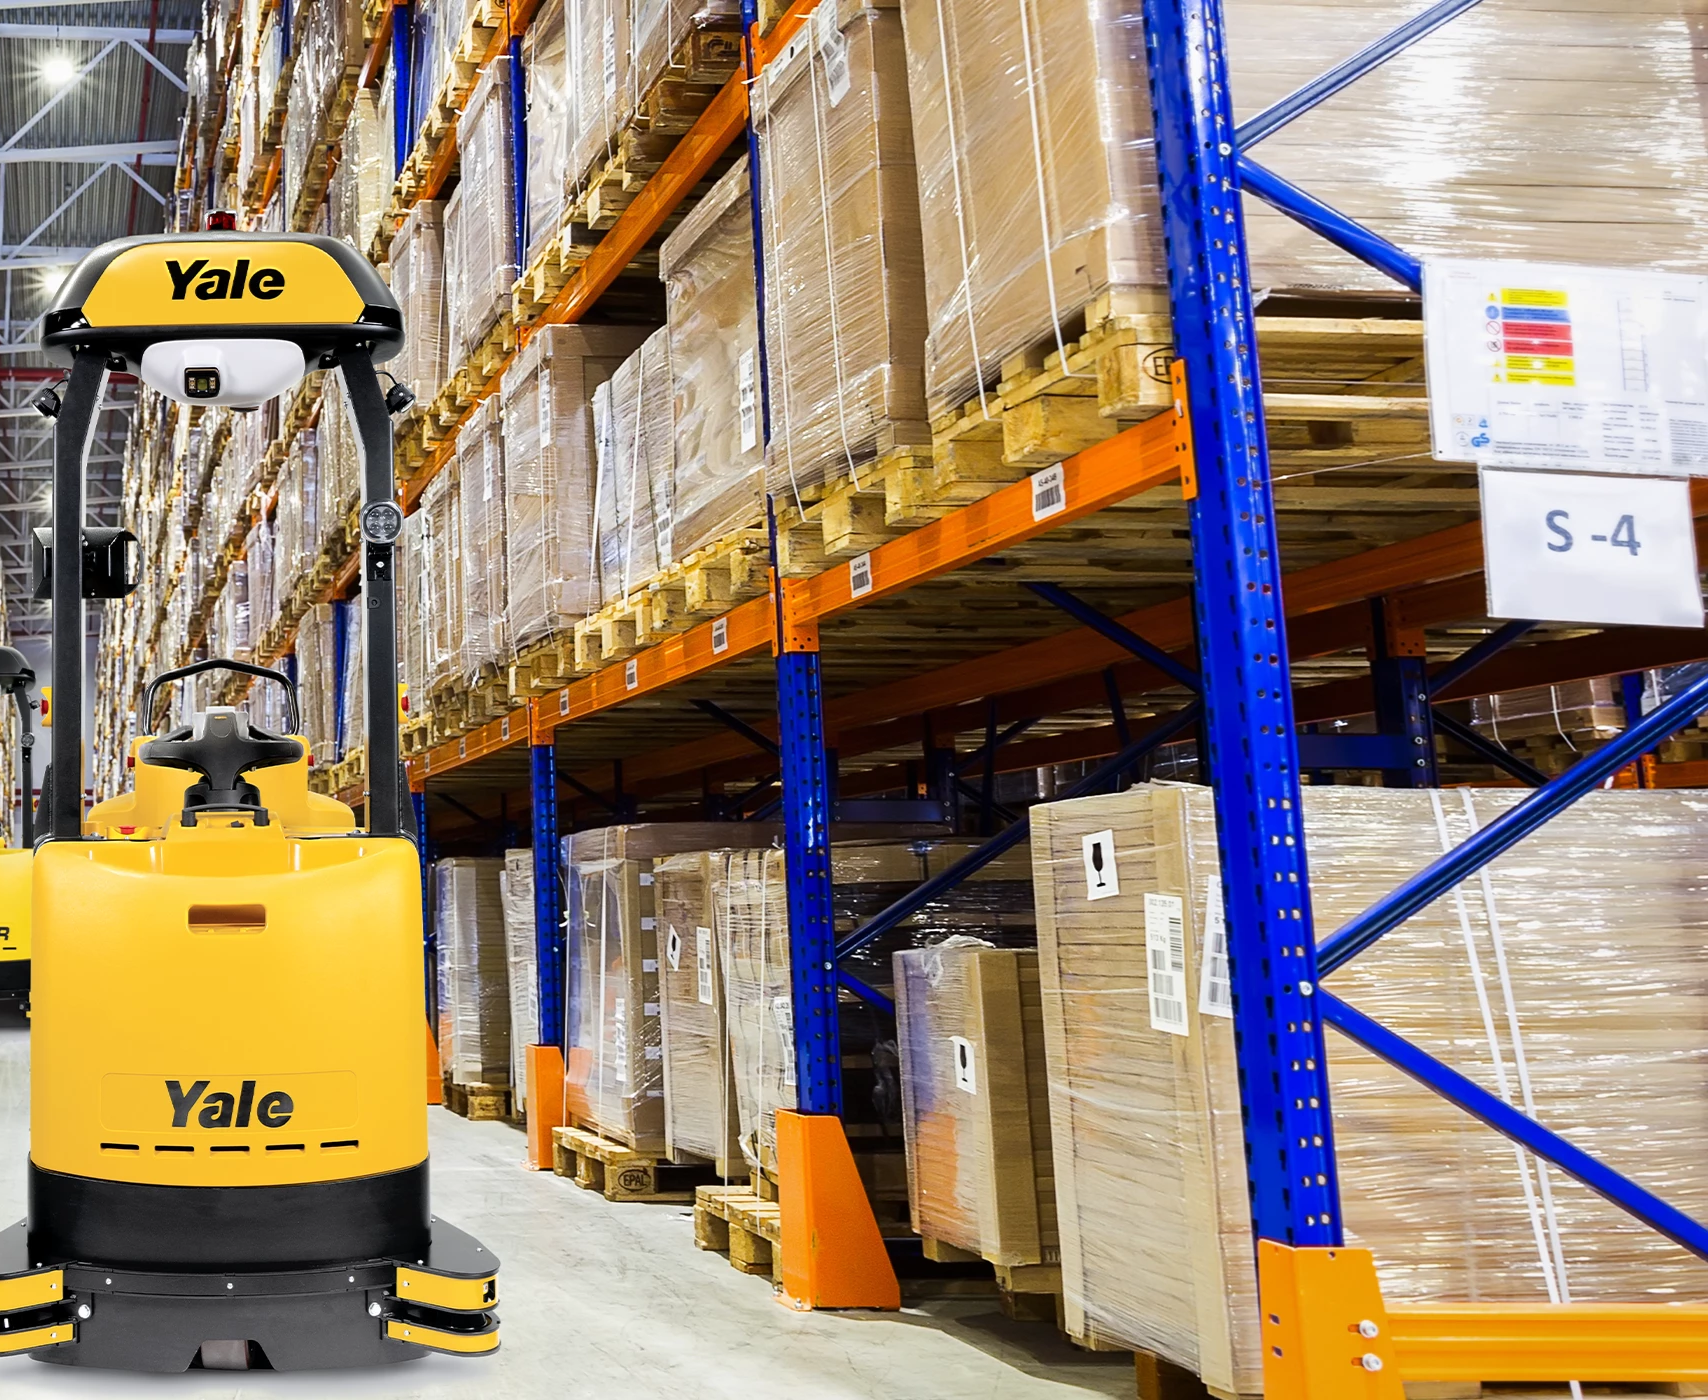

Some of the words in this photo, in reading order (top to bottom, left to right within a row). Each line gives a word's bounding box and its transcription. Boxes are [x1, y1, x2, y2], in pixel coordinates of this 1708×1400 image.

[165, 260, 286, 301] Yale
[1546, 510, 1573, 553] S
[1591, 513, 1641, 556] -4
[165, 1080, 294, 1129] Yale
[623, 1174, 647, 1187] EPAL
